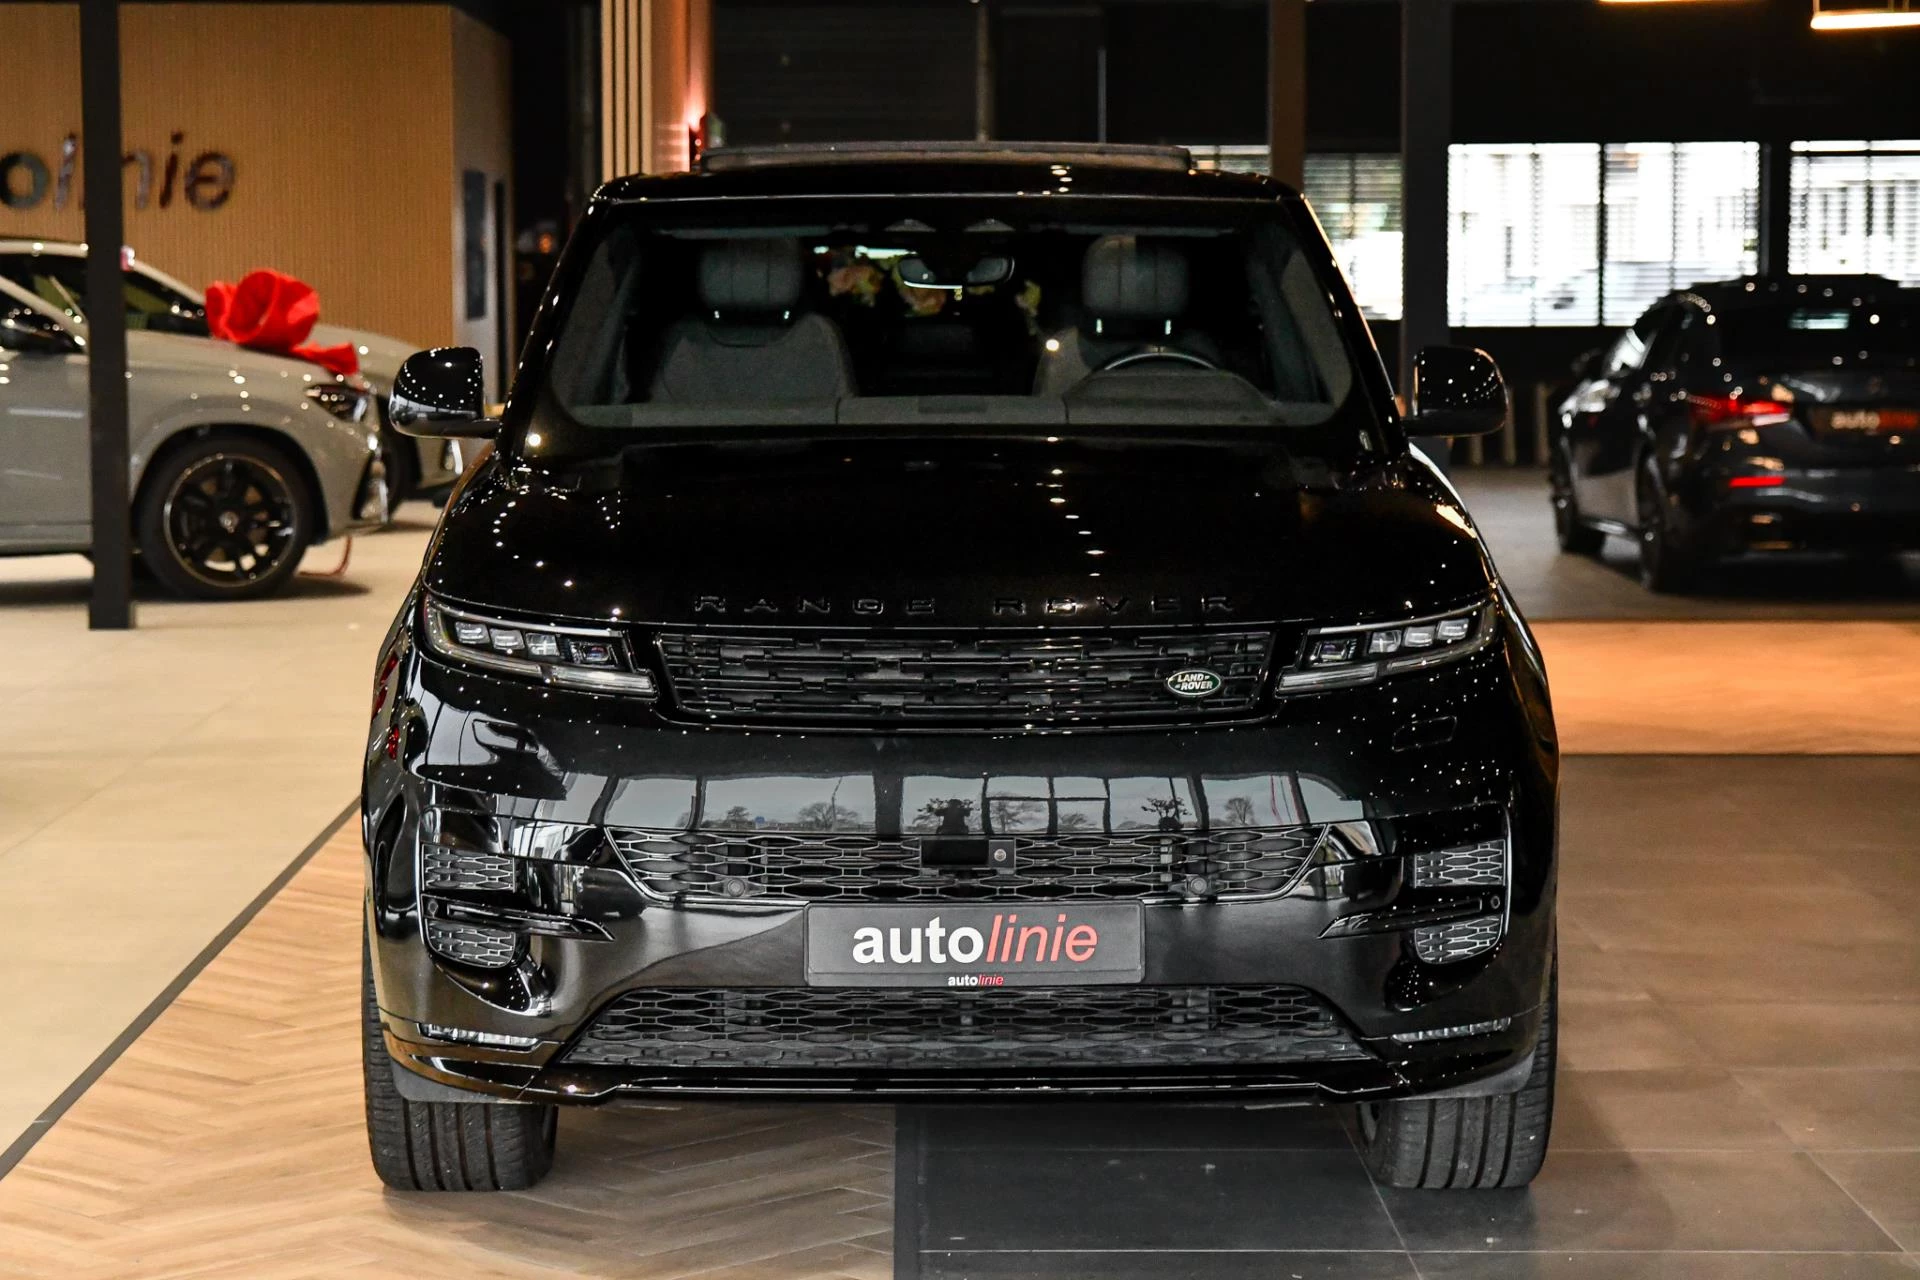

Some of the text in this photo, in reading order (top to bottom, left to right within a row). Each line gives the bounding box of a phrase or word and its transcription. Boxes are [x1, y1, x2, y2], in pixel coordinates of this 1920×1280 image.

[0, 131, 235, 210] olnie
[694, 596, 1234, 615] RANGE ROVER
[1181, 681, 1213, 690] ROVER
[852, 914, 1098, 964] autolinie
[948, 974, 1004, 986] autolinie
